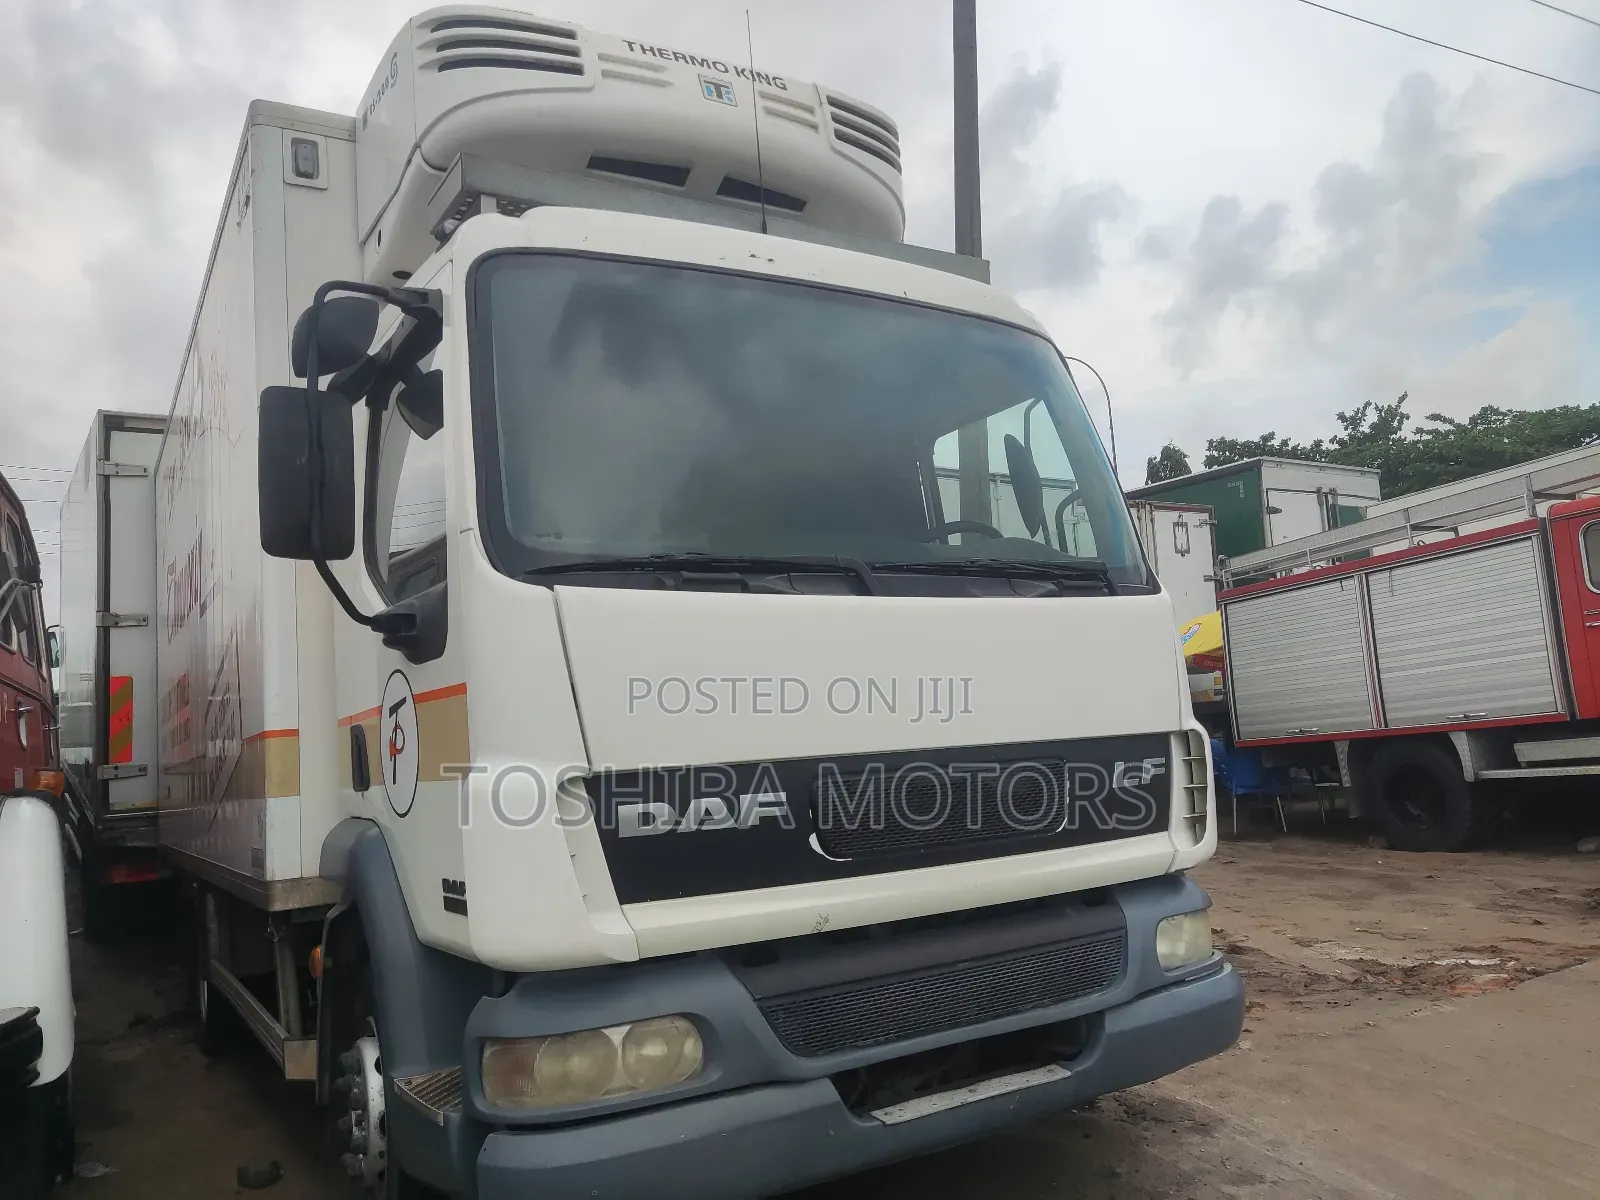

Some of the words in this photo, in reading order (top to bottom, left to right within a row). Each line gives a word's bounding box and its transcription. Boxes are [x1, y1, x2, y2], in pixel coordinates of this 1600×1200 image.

[622, 39, 730, 74] THERMO
[733, 65, 788, 91] KING
[1113, 757, 1166, 788] LF
[618, 792, 787, 838] DAF
